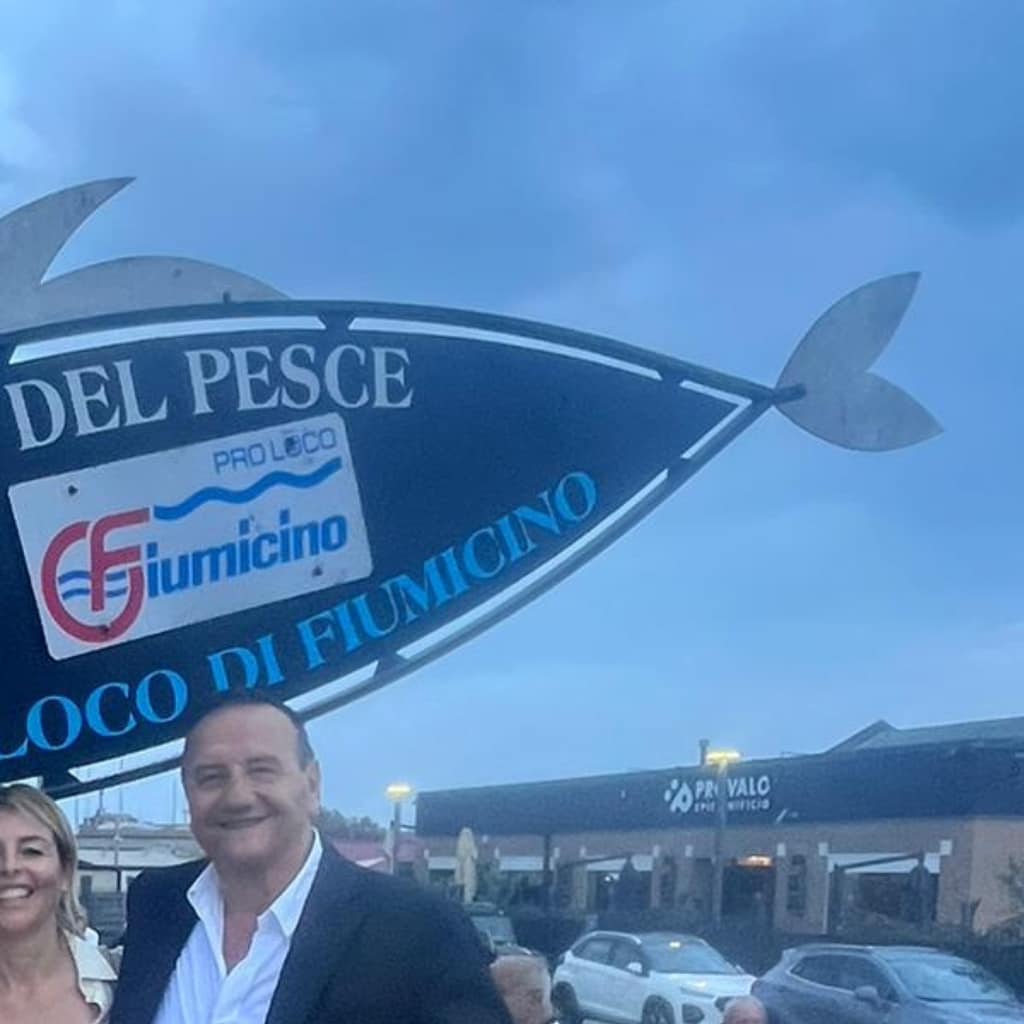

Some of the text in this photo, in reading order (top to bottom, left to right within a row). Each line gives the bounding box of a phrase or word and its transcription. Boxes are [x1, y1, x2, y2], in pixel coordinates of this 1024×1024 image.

[3, 359, 167, 451] DEL
[184, 343, 414, 416] PESCE
[213, 441, 266, 474] PRO
[296, 471, 597, 670] FIUMICINO
